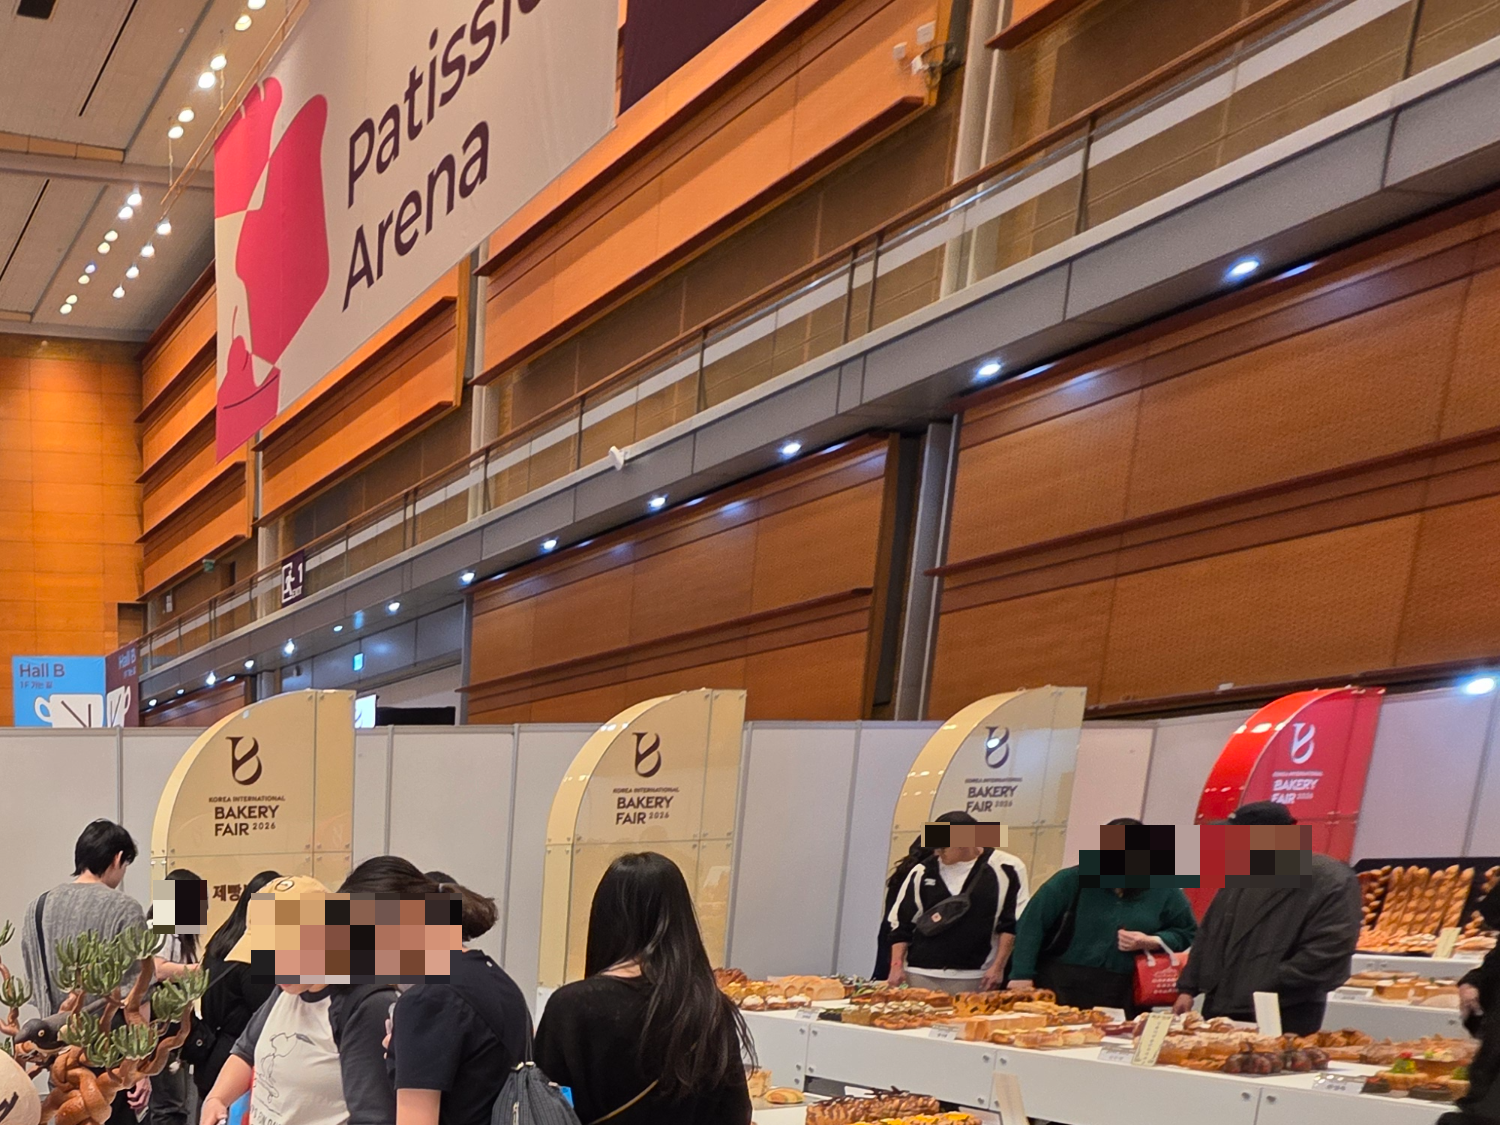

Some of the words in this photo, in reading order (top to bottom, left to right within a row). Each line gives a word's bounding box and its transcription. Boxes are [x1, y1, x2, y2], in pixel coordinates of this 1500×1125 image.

[348, 0, 542, 209] Patiss
[342, 121, 489, 313] Arena
[19, 662, 49, 678] Hall
[53, 663, 65, 678] B
[967, 785, 1018, 798] BAKERY
[1273, 779, 1319, 791] BAKERY
[617, 796, 674, 809] BAKERY
[214, 805, 279, 820] BAKERY
[615, 812, 646, 825] FAIR
[214, 823, 249, 836] FAIR
[252, 822, 276, 830] 2026
[212, 884, 248, 902] 제빵
